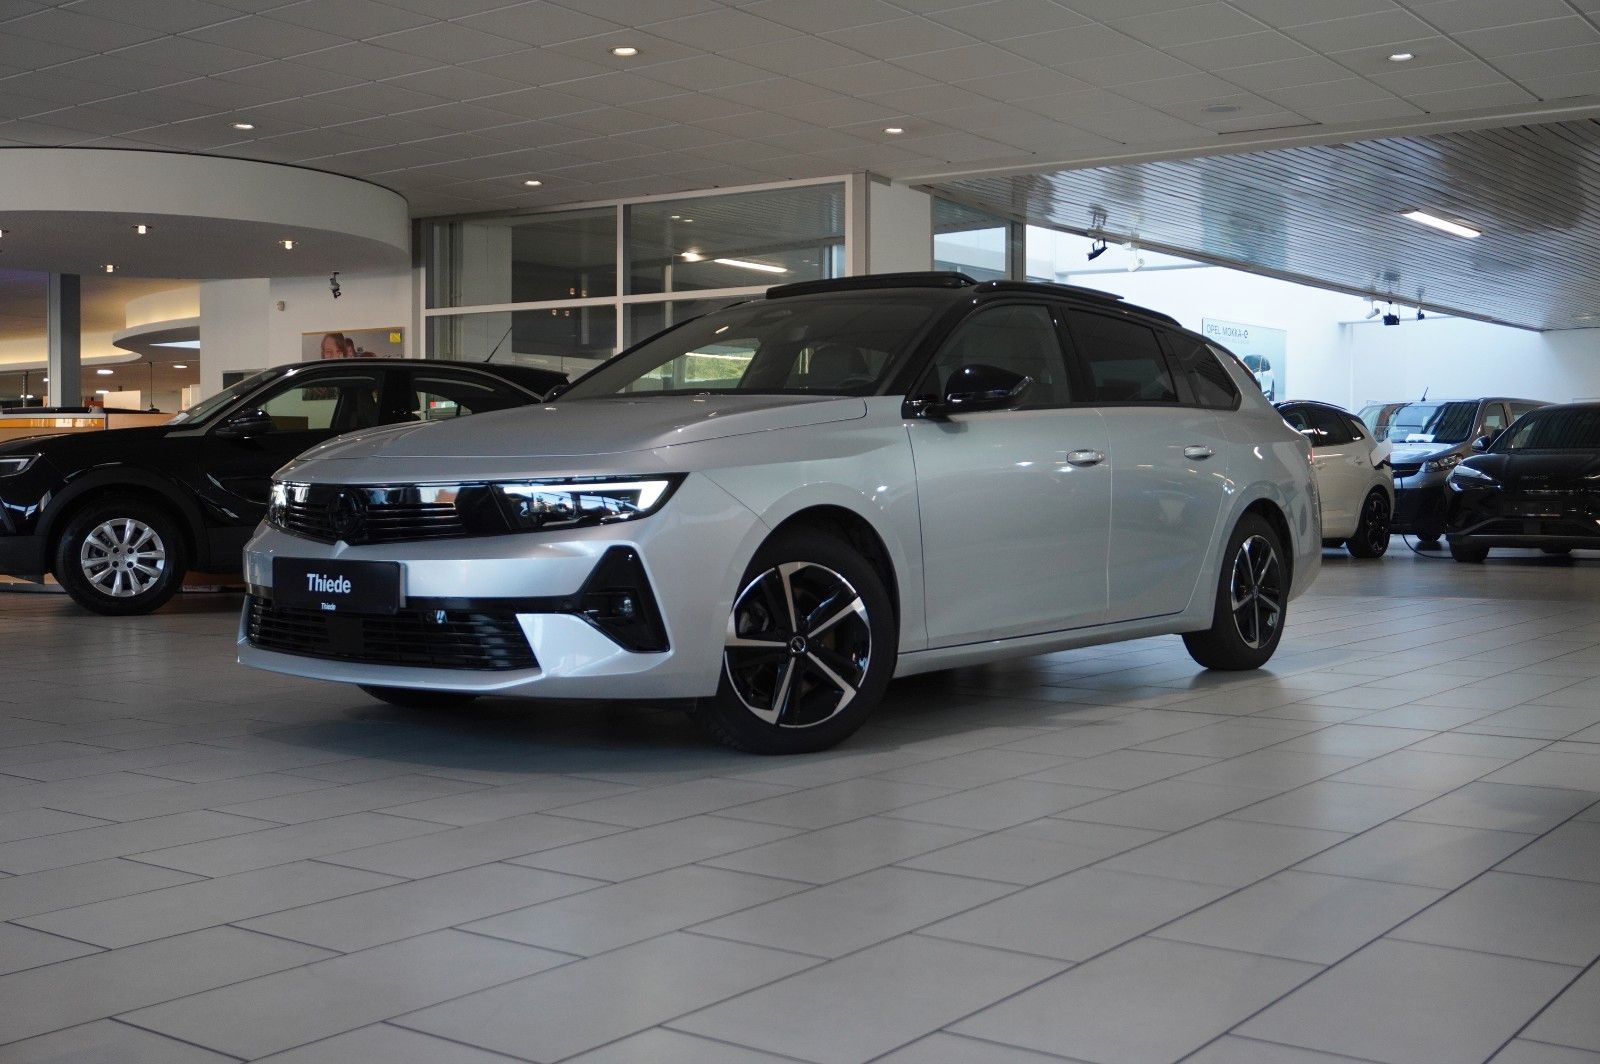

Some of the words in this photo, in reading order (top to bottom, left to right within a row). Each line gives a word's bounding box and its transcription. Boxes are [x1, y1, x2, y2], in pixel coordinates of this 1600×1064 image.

[1206, 323, 1221, 335] OPEL
[306, 573, 352, 594] Thiede
[321, 602, 336, 611] Thiede
